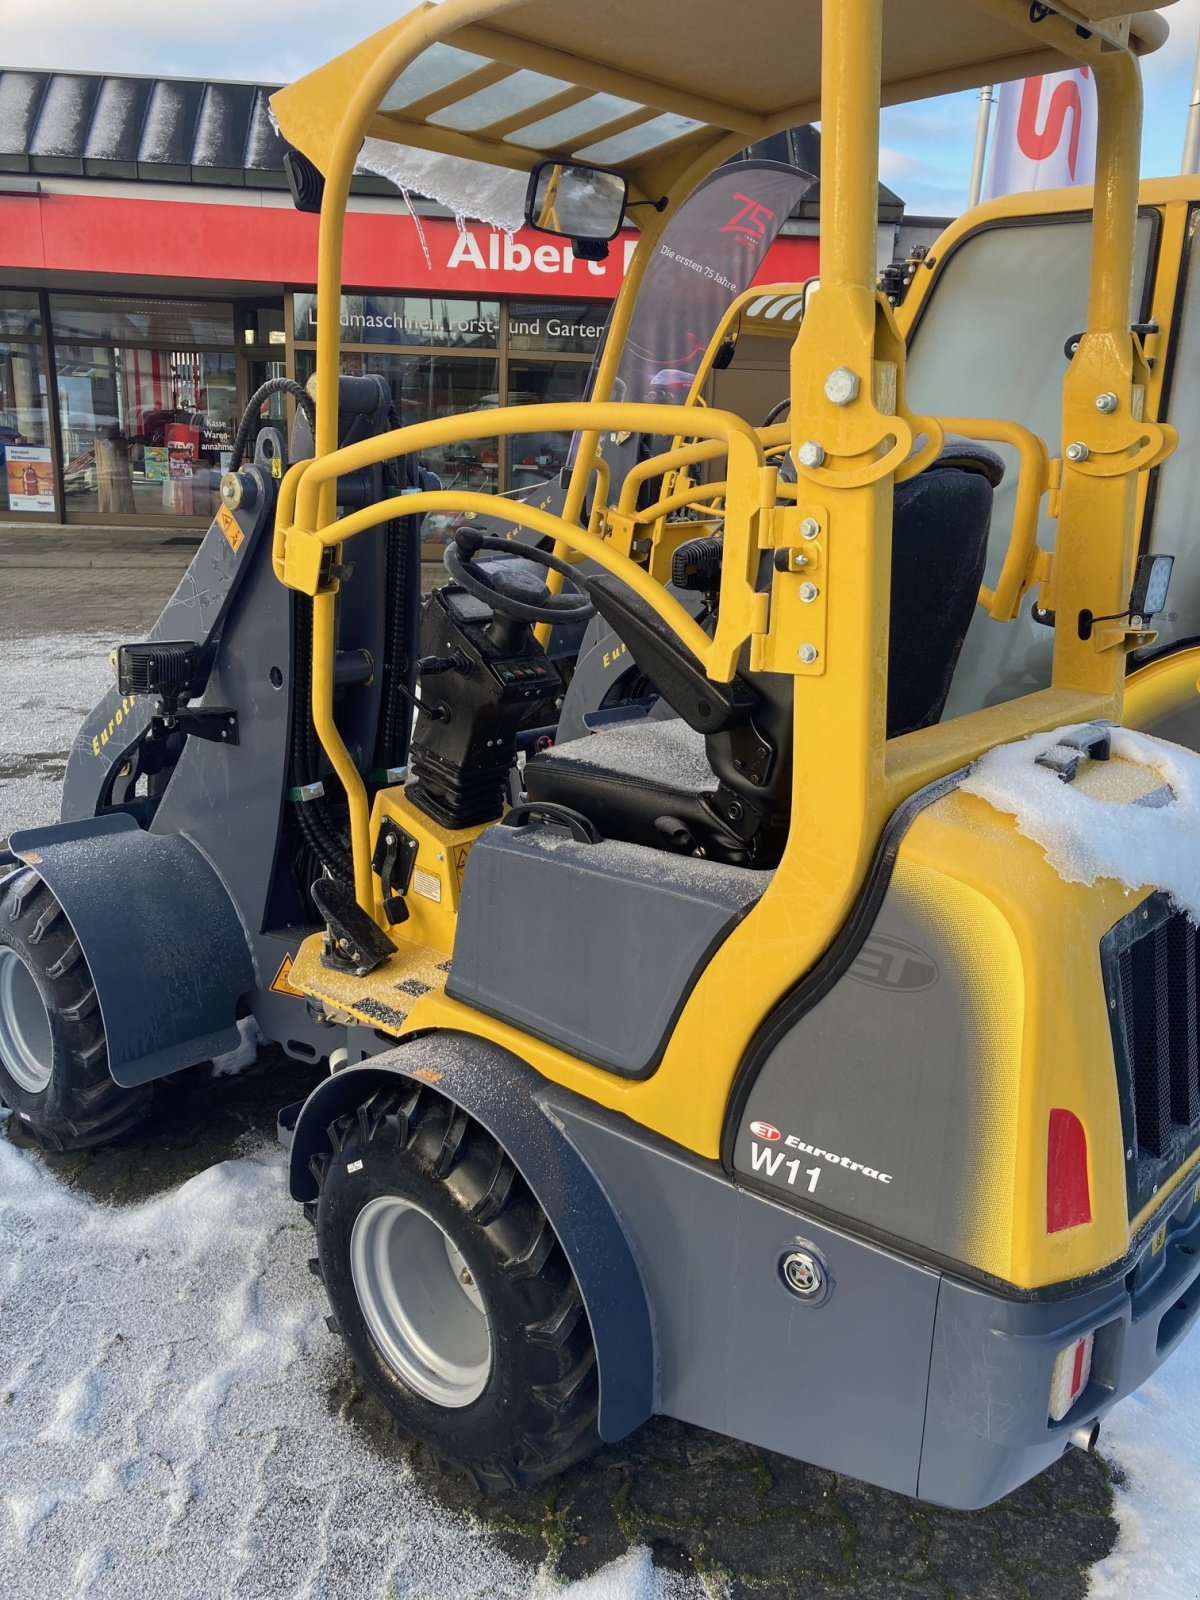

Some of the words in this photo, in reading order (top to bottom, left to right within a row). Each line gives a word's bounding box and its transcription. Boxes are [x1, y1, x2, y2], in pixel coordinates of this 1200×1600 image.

[660, 245, 675, 259] Die
[675, 254, 703, 273] ersten
[703, 266, 716, 279] 75
[714, 272, 738, 293] Jahre.
[308, 307, 444, 332] Ldmaschinen,
[508, 318, 540, 335] und
[203, 430, 230, 440] Waren-
[206, 418, 227, 428] Kasse
[201, 442, 234, 451] annahme
[751, 1141, 822, 1193] W11
[784, 1134, 893, 1184] Eurotrac
